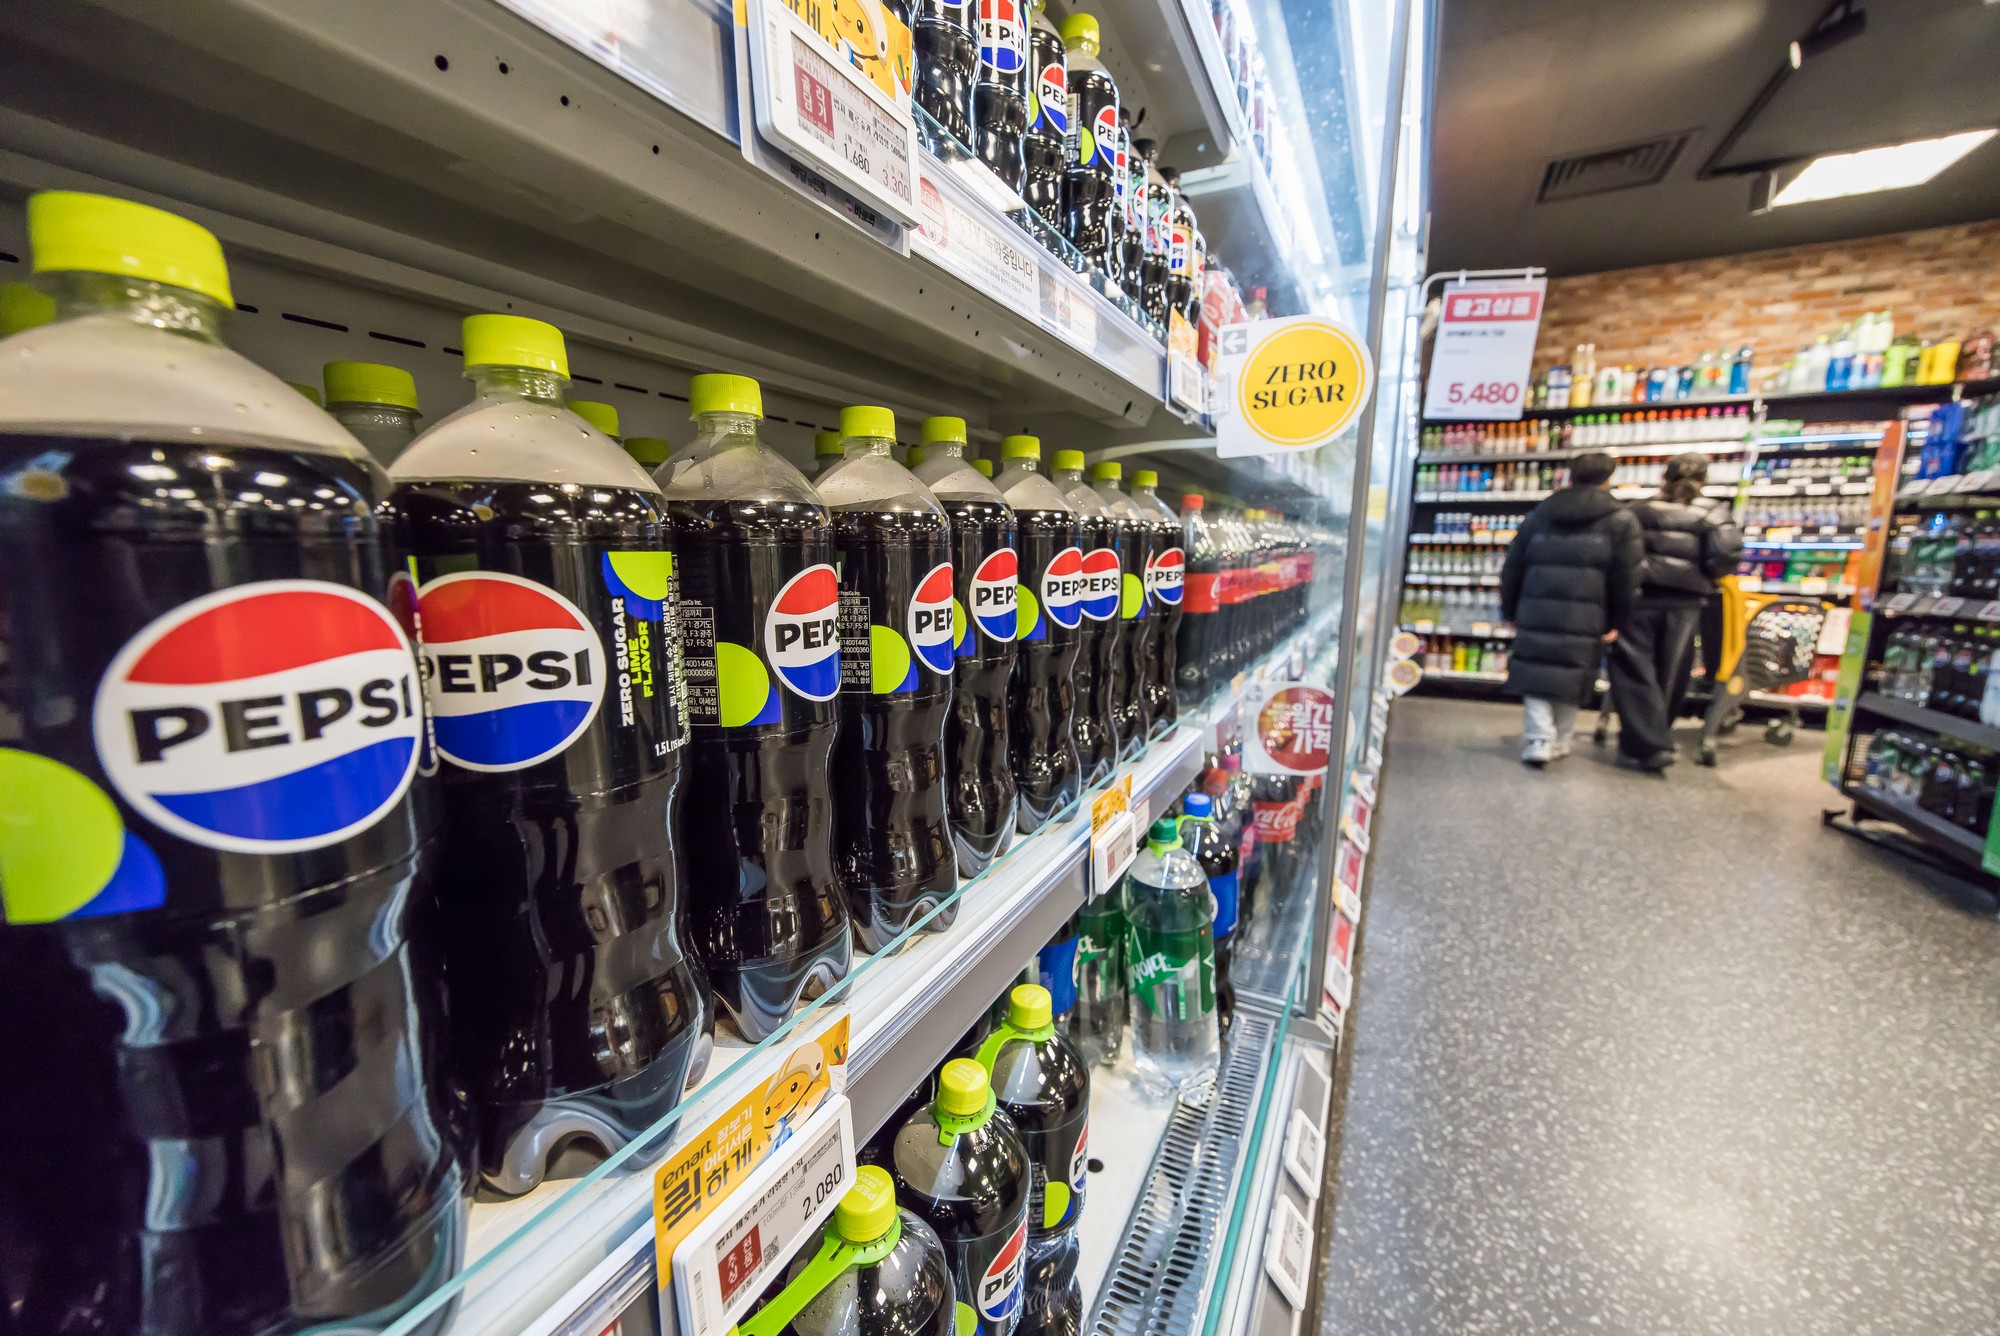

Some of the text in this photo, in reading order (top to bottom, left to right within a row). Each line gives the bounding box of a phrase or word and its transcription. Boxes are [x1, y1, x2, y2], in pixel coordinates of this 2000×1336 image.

[1265, 359, 1337, 386] ZERO
[1447, 382, 1519, 404] 5,480
[1252, 382, 1345, 411] SUGAR
[611, 598, 635, 727] ZERO SUGAR
[627, 638, 643, 685] LIME
[637, 620, 655, 698] FLAVOR
[127, 672, 413, 764] PEPSI
[1292, 703, 1333, 729] 월간
[1292, 729, 1331, 754] 가격
[704, 1122, 753, 1173] 어디서든
[717, 1105, 753, 1145] 장보기
[662, 1140, 712, 1190] emart
[802, 1163, 842, 1221] 2,080
